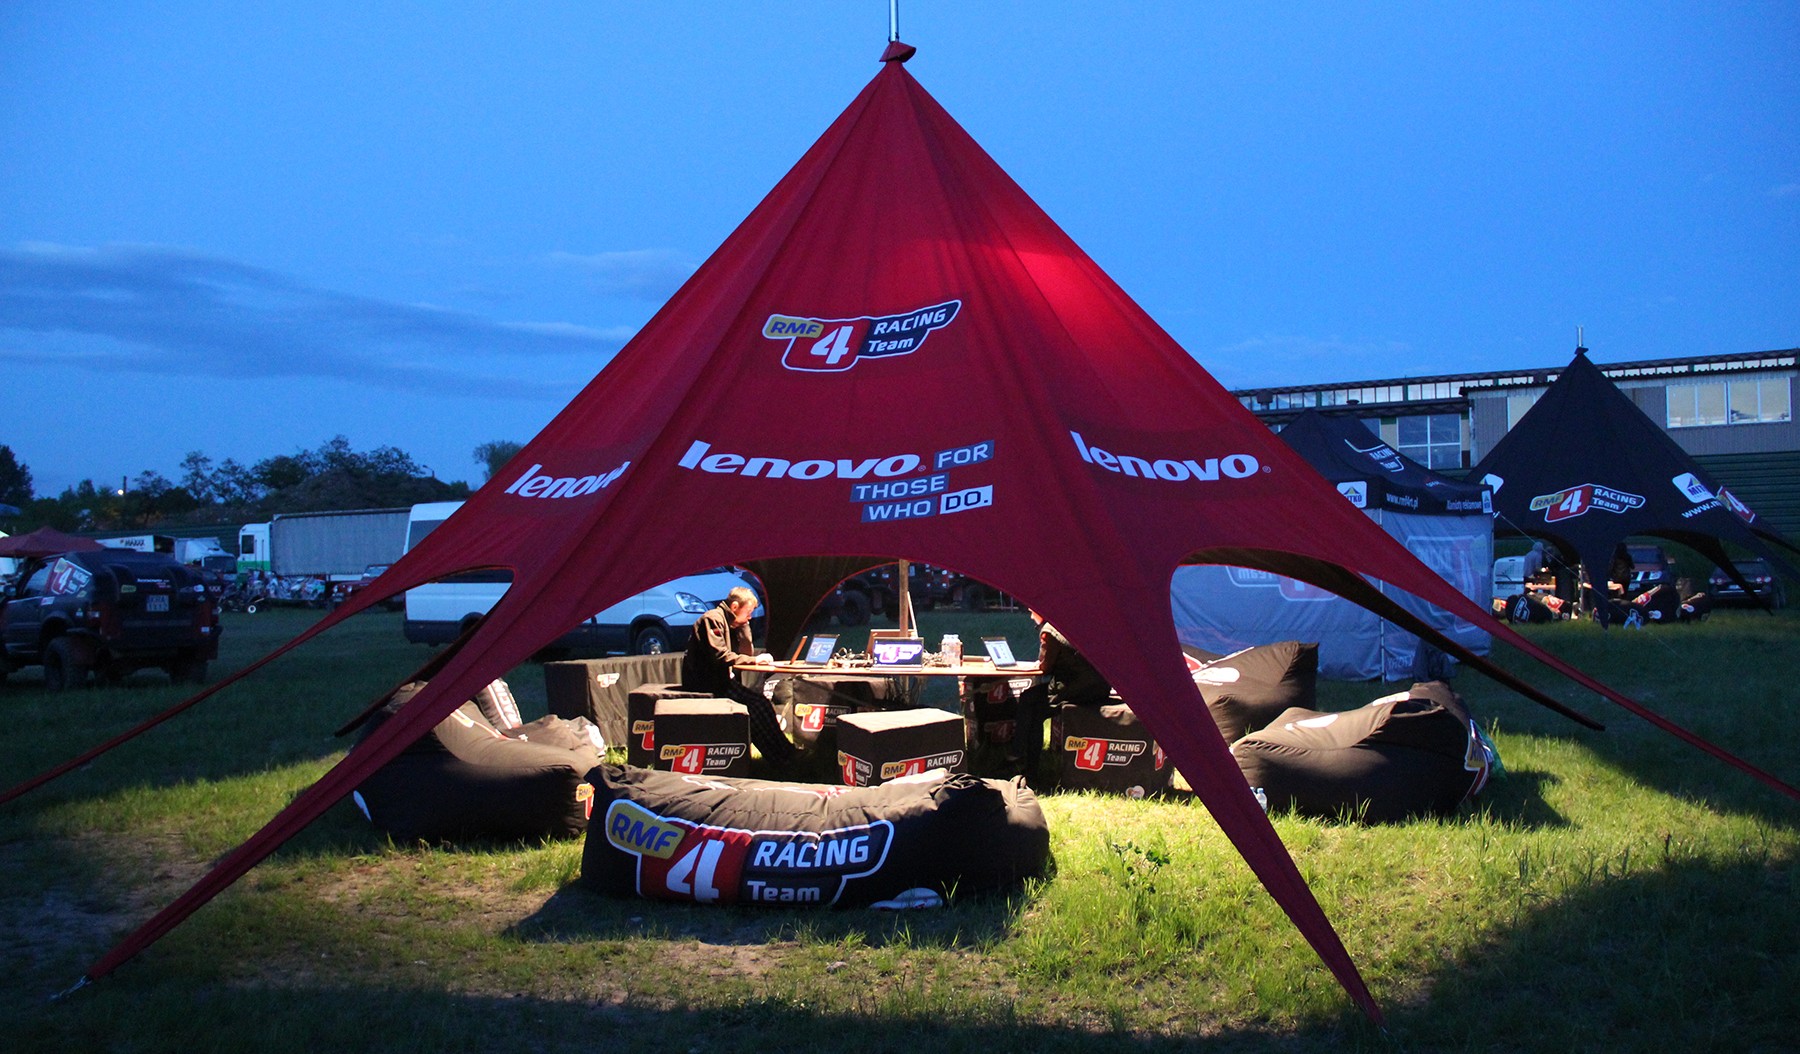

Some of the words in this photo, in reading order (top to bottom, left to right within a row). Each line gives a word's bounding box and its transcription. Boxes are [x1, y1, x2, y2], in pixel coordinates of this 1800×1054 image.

[770, 321, 820, 334] RMF
[873, 308, 947, 335] RACING
[810, 325, 854, 364] 4
[868, 337, 914, 353] Team
[677, 440, 921, 480] lenovo
[938, 443, 989, 466] FOR
[1070, 430, 1259, 482] lenovo
[854, 475, 945, 499] THOSE
[1593, 488, 1637, 505] RACING
[867, 499, 931, 520] WHO
[944, 490, 989, 511] DO.
[1559, 489, 1582, 513] 4
[1592, 497, 1619, 510] Team
[808, 707, 821, 728] 4
[663, 748, 685, 756] RMF
[707, 746, 740, 755] RACING
[1068, 740, 1087, 748] RMF
[1083, 742, 1101, 766] 4
[1108, 742, 1141, 752] RACING
[682, 748, 699, 772] 4
[705, 758, 727, 766] Team
[926, 755, 958, 768] RACING
[1106, 753, 1127, 762] Team
[884, 765, 905, 776] RMF
[611, 813, 679, 852] RMF
[753, 835, 869, 868] RACING
[666, 839, 726, 904] 4
[747, 880, 820, 901] Team
